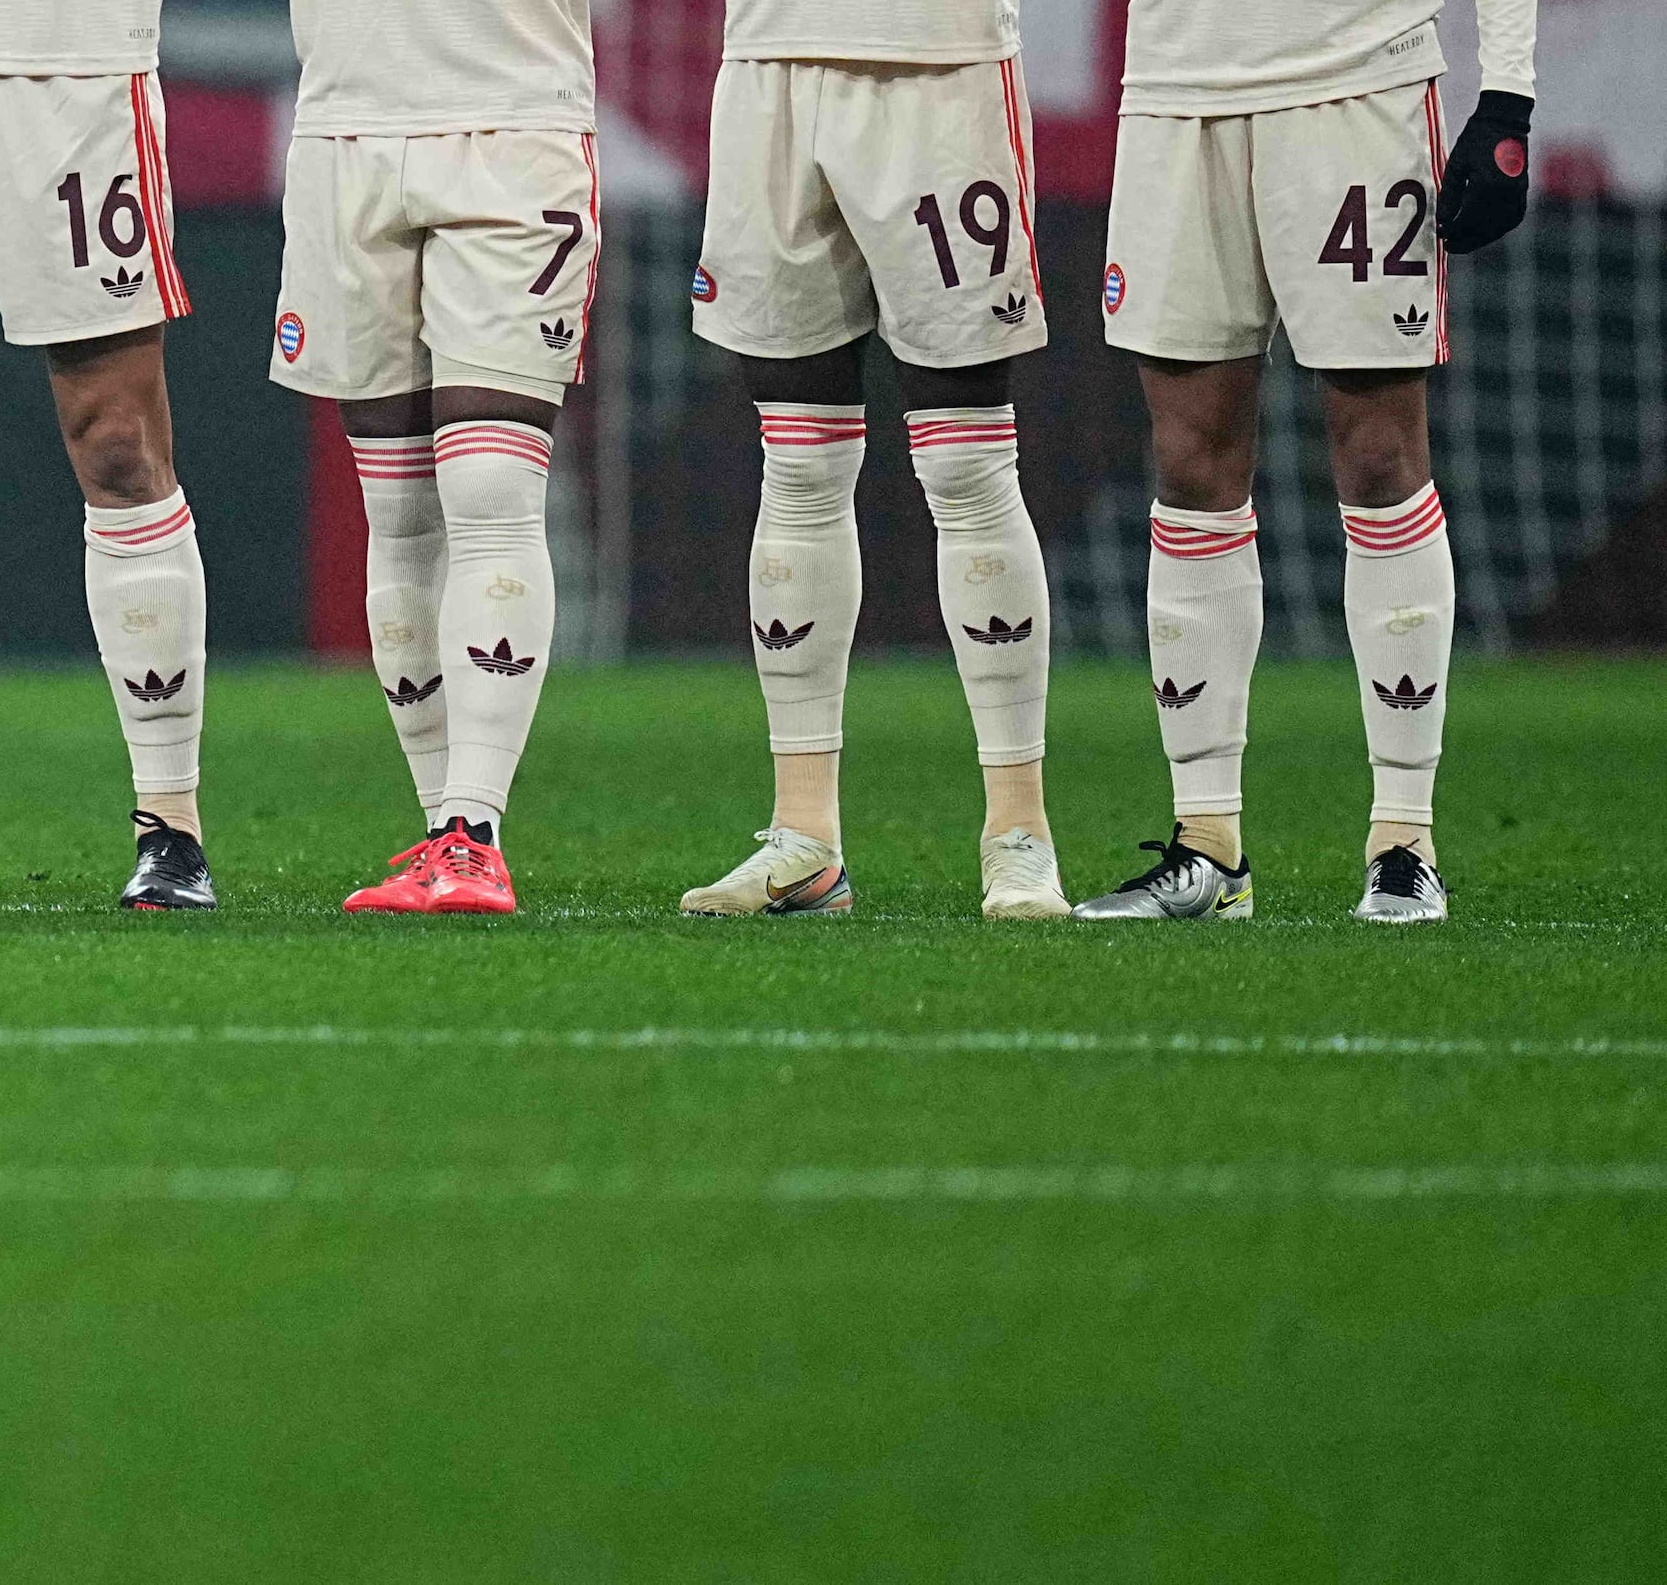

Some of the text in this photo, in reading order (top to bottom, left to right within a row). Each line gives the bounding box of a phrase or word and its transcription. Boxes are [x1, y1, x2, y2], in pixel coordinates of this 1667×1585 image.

[57, 173, 147, 268] 16
[528, 210, 583, 295] 7
[914, 179, 1010, 289] 19
[1318, 179, 1428, 282] 42
